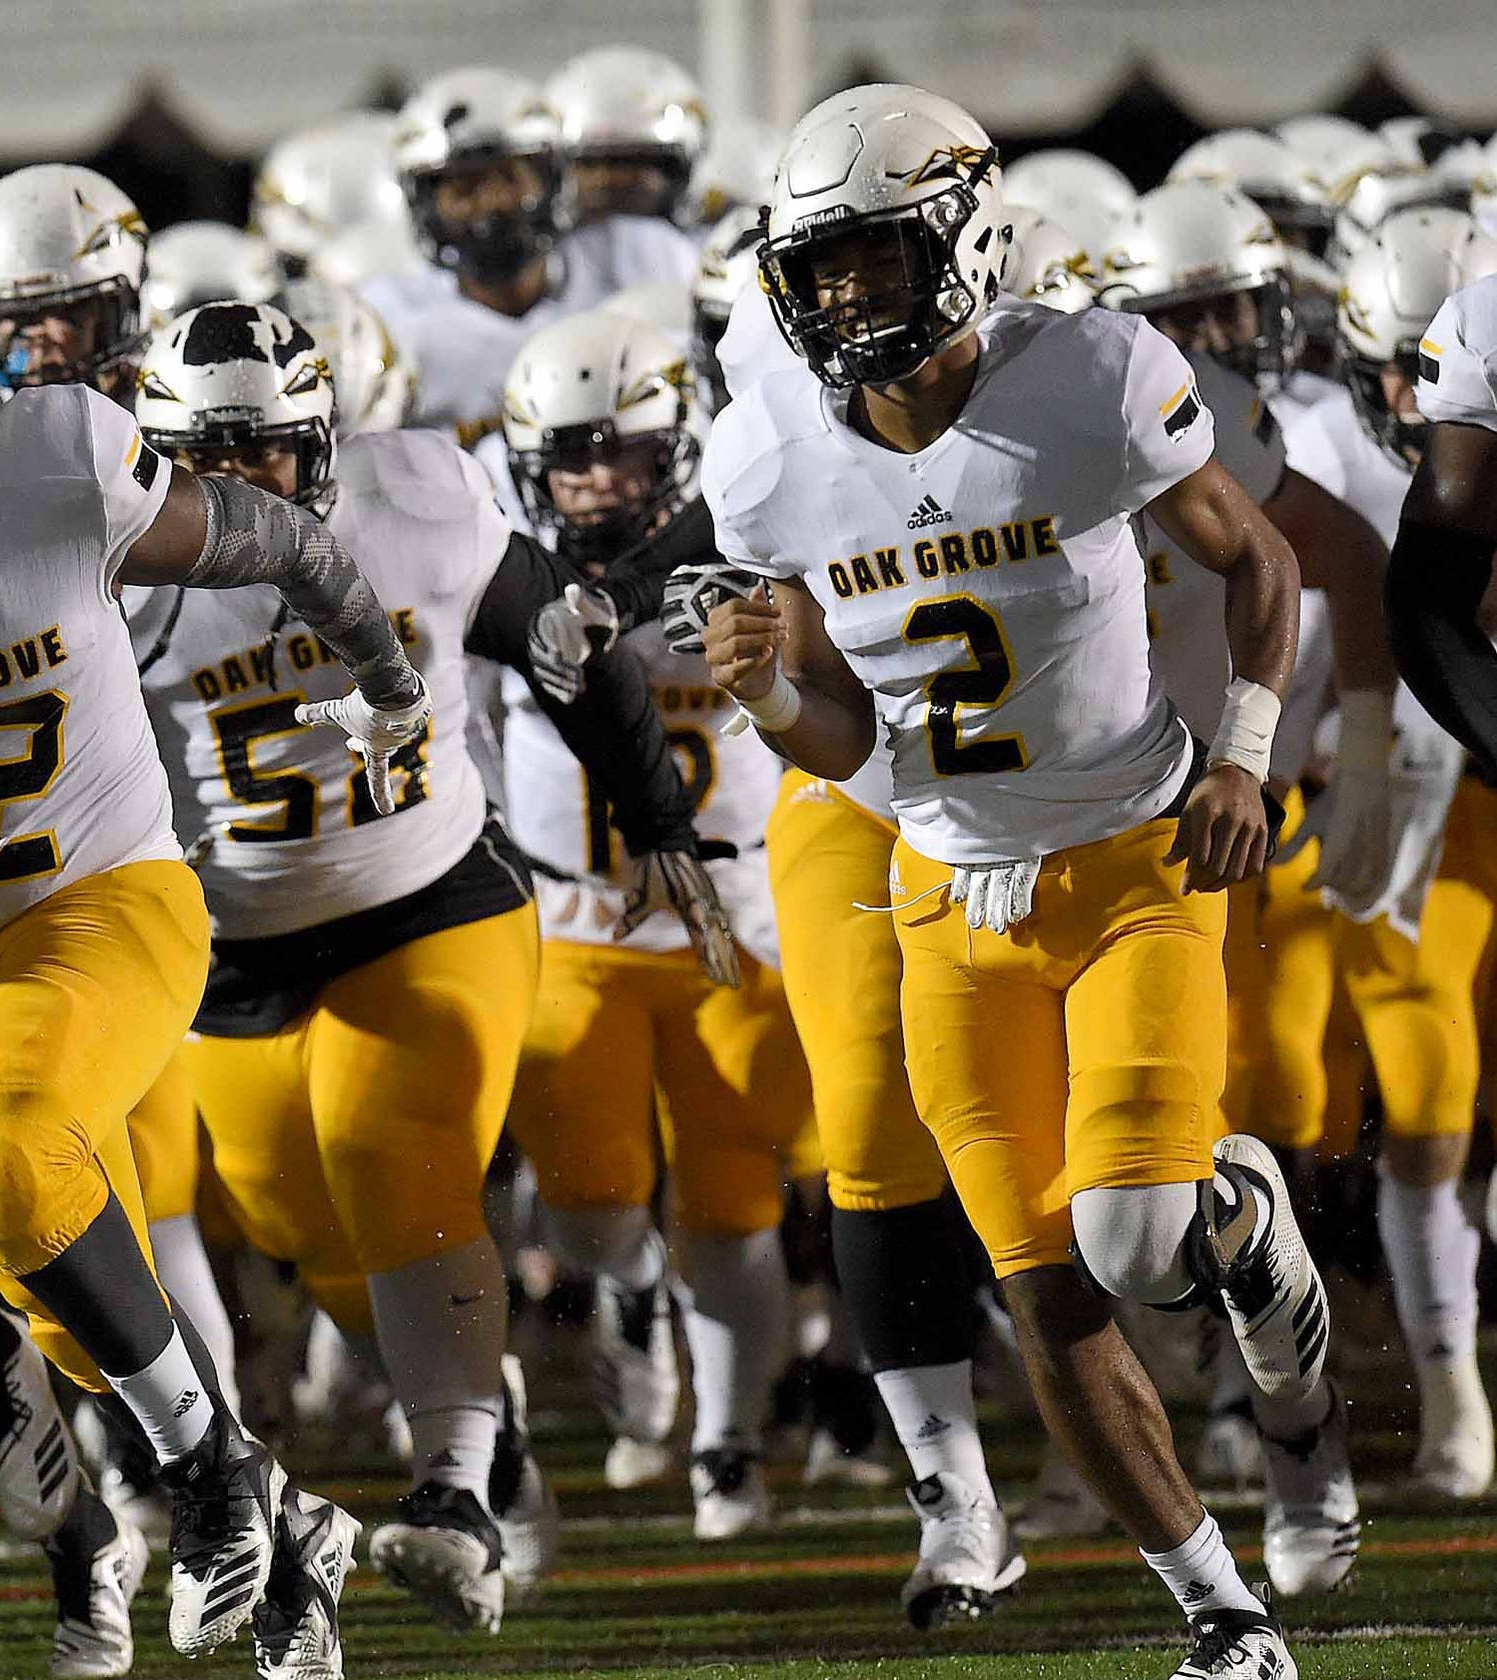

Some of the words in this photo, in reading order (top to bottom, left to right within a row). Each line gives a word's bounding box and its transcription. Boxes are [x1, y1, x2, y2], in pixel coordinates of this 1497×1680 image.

[907, 511, 952, 530] adidas
[827, 545, 908, 600] OAK
[913, 515, 1060, 580] GROVE
[193, 643, 280, 701] OAK
[901, 591, 1029, 780] 2
